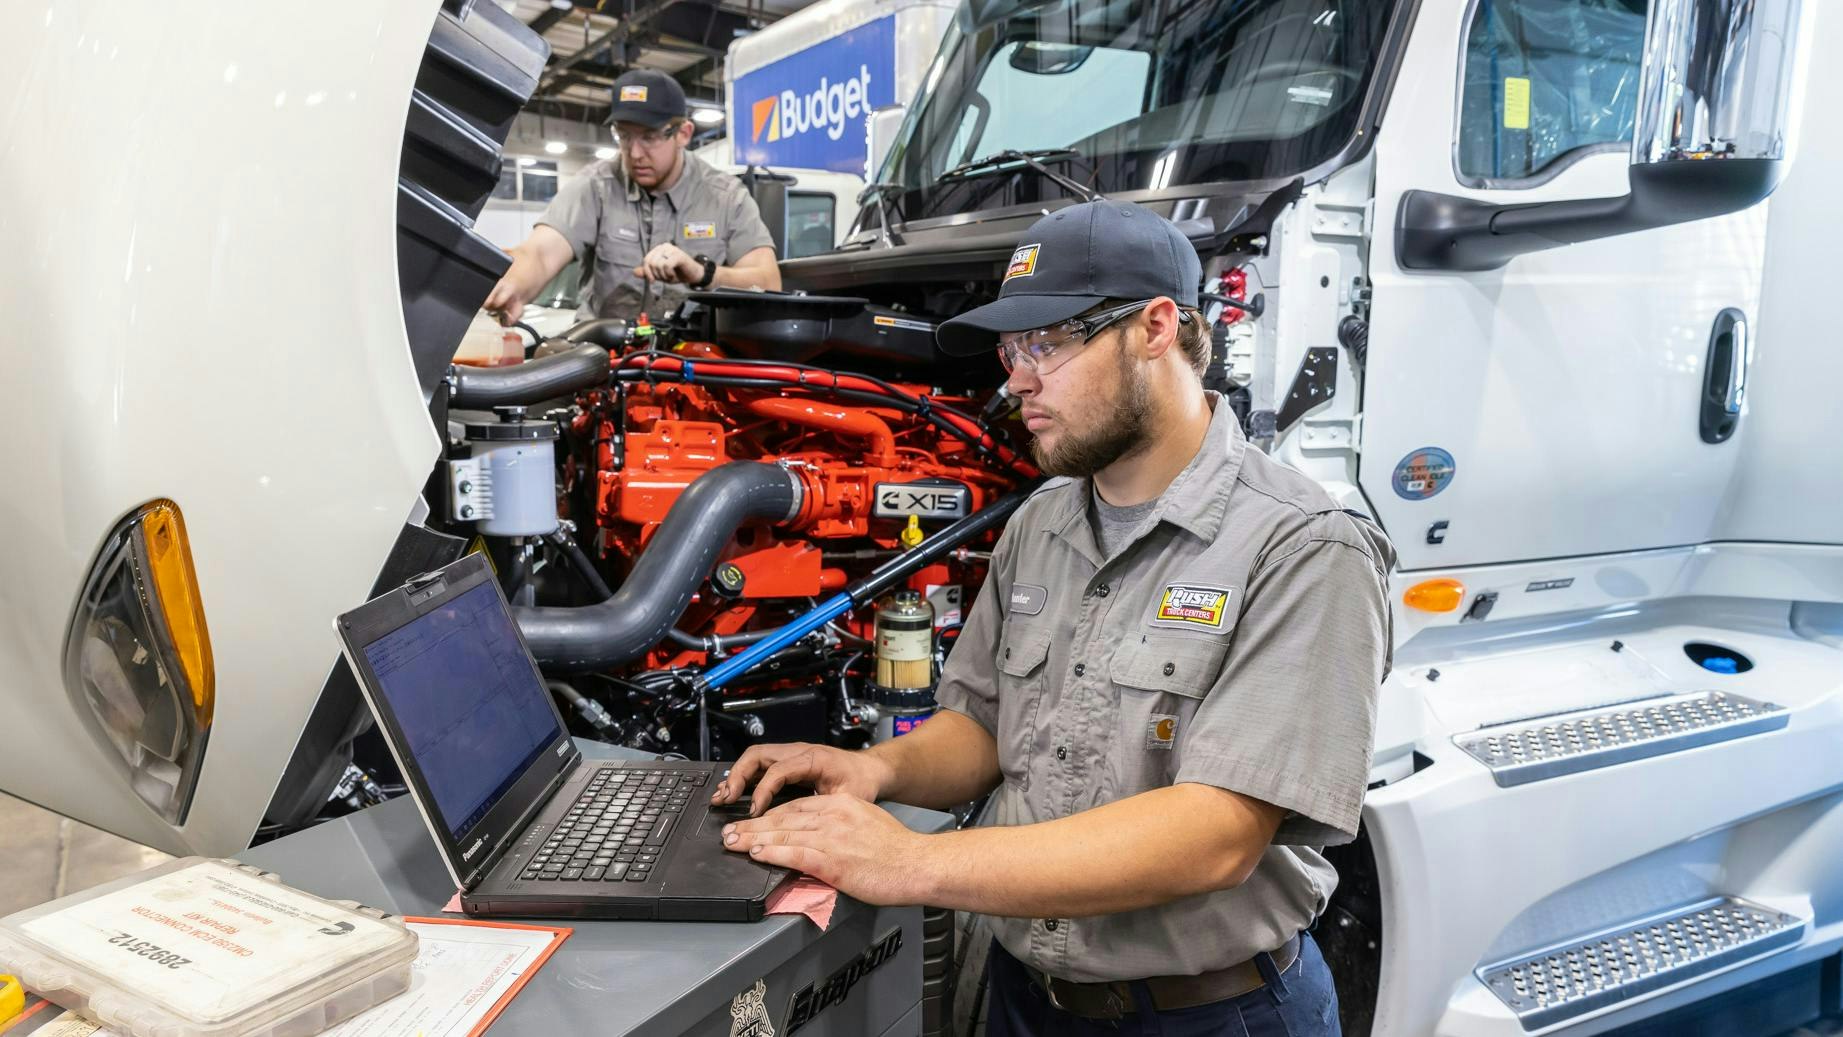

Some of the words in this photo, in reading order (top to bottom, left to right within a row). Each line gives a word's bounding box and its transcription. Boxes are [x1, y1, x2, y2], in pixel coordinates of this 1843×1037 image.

[781, 64, 871, 141] Budget
[906, 493, 959, 511] X15
[1166, 588, 1222, 609] RUSH
[1167, 608, 1184, 616] TRUCK
[1184, 609, 1211, 619] CENTERS
[463, 838, 483, 862] Panasonic
[130, 904, 196, 933] CONNECTOR
[182, 911, 203, 922] KIT
[201, 915, 241, 935] REPAIR
[187, 928, 217, 943] ECM
[107, 932, 193, 970] 2892512
